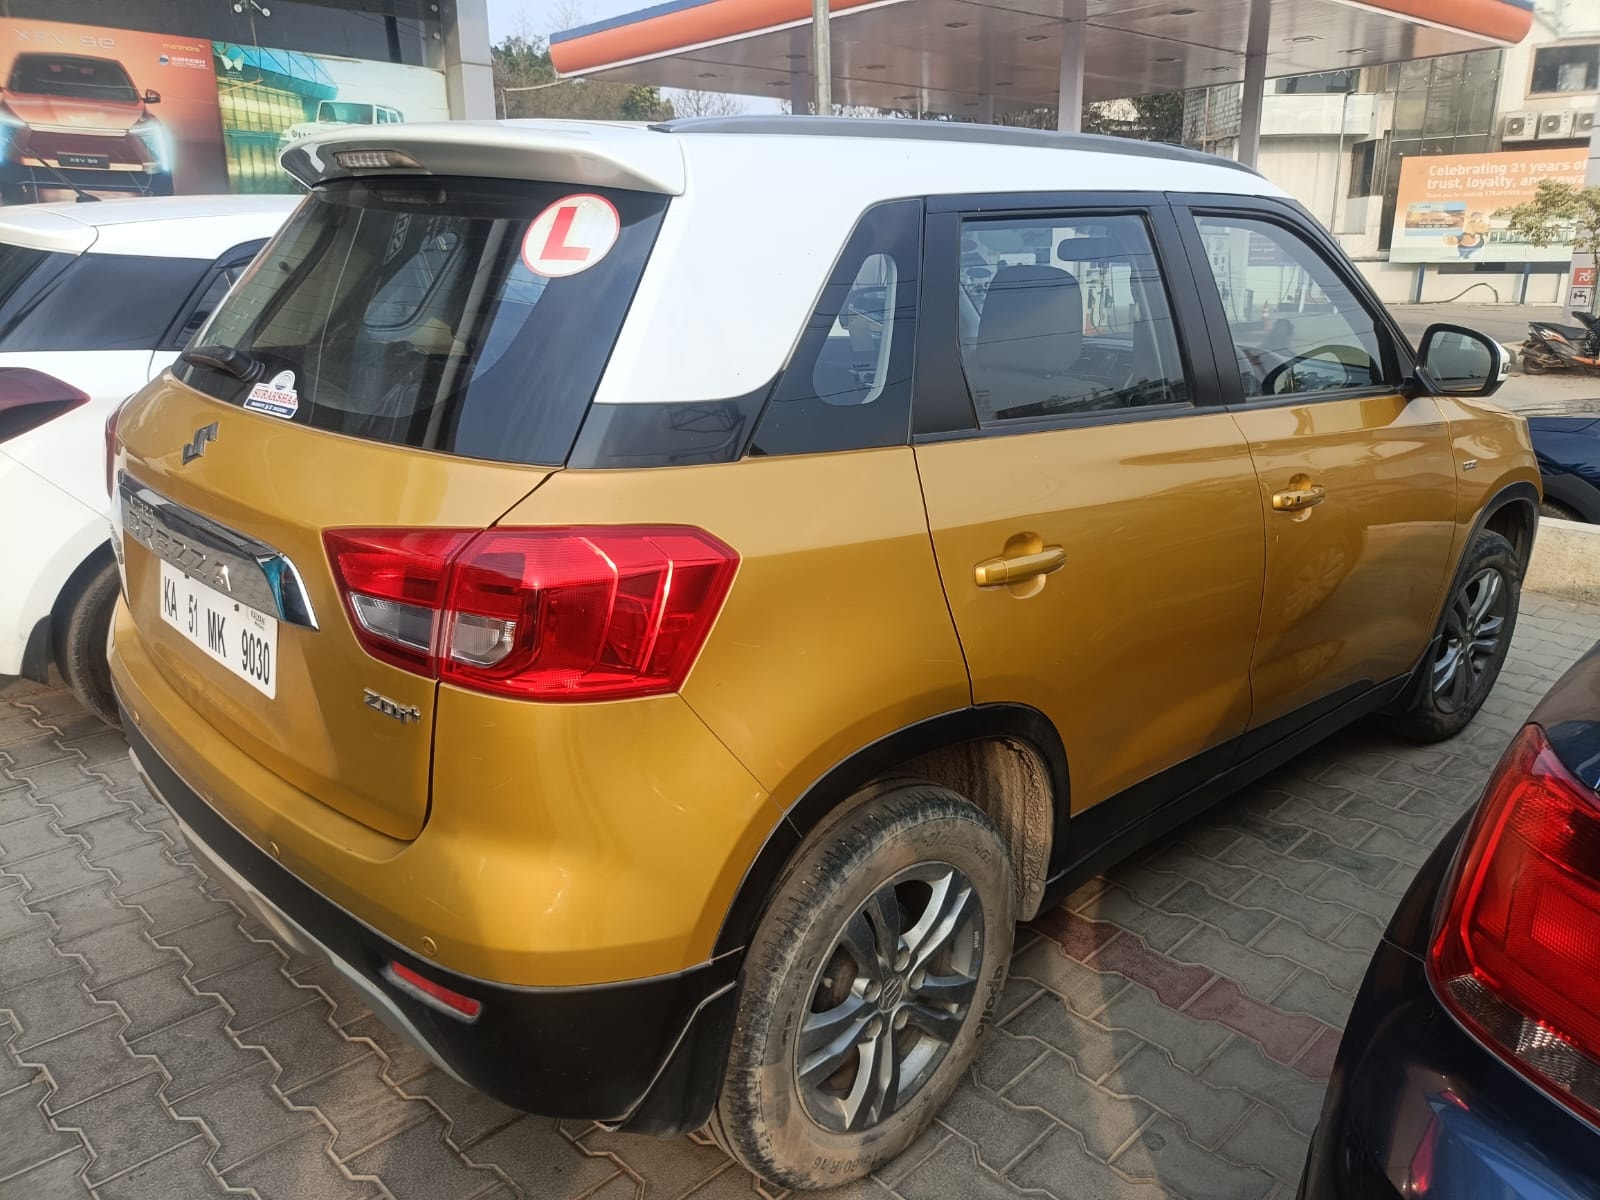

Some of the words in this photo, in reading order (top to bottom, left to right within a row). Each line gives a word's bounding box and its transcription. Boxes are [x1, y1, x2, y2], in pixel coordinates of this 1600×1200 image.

[1427, 178, 1463, 190] trust,
[1466, 175, 1516, 190] loyalty,
[1520, 174, 1546, 187] and
[1429, 162, 1506, 176] Celebrating
[1511, 163, 1526, 173] 21
[1530, 160, 1569, 174] years
[540, 206, 590, 261] L
[128, 510, 232, 592] BREZZA
[164, 575, 178, 621] KA
[188, 594, 198, 637] 51
[207, 607, 226, 658] MK
[241, 628, 270, 686] 9030
[974, 965, 1004, 1039] apollo
